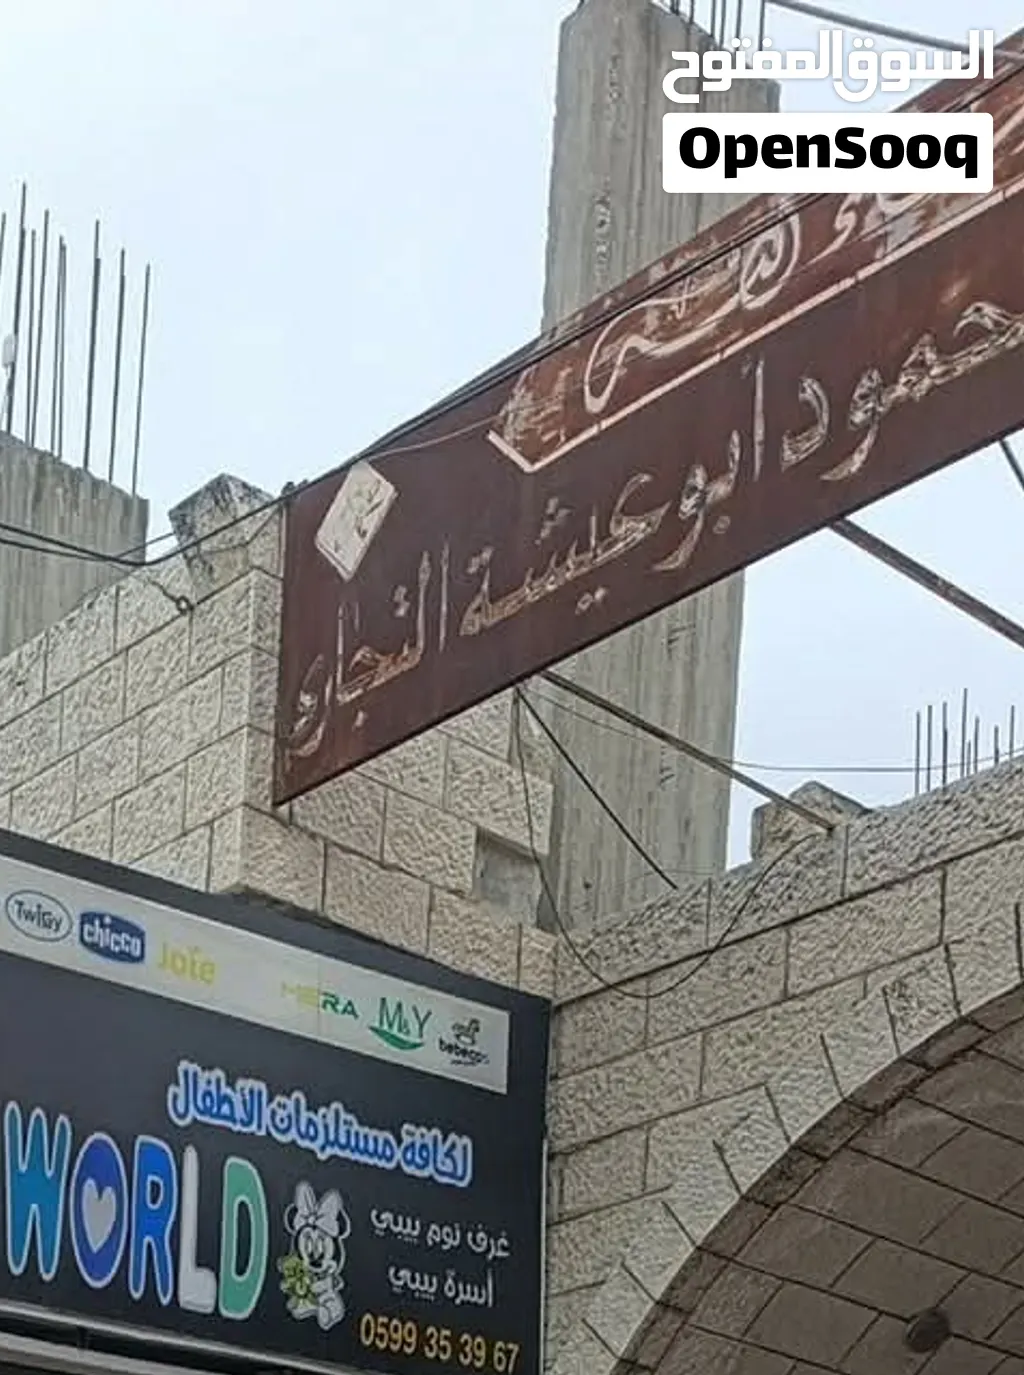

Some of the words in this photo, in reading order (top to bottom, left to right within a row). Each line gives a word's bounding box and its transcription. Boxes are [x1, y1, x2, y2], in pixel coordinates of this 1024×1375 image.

[81, 918, 144, 958] chicco
[267, 1090, 399, 1170] مستلزمات
[400, 1123, 473, 1187] لكافة
[3, 1100, 270, 1321] WORLD
[426, 1223, 461, 1250] نوم
[467, 1223, 511, 1261] غرف
[359, 1312, 419, 1356] 0599
[422, 1325, 453, 1362] 35
[458, 1332, 487, 1369] 39
